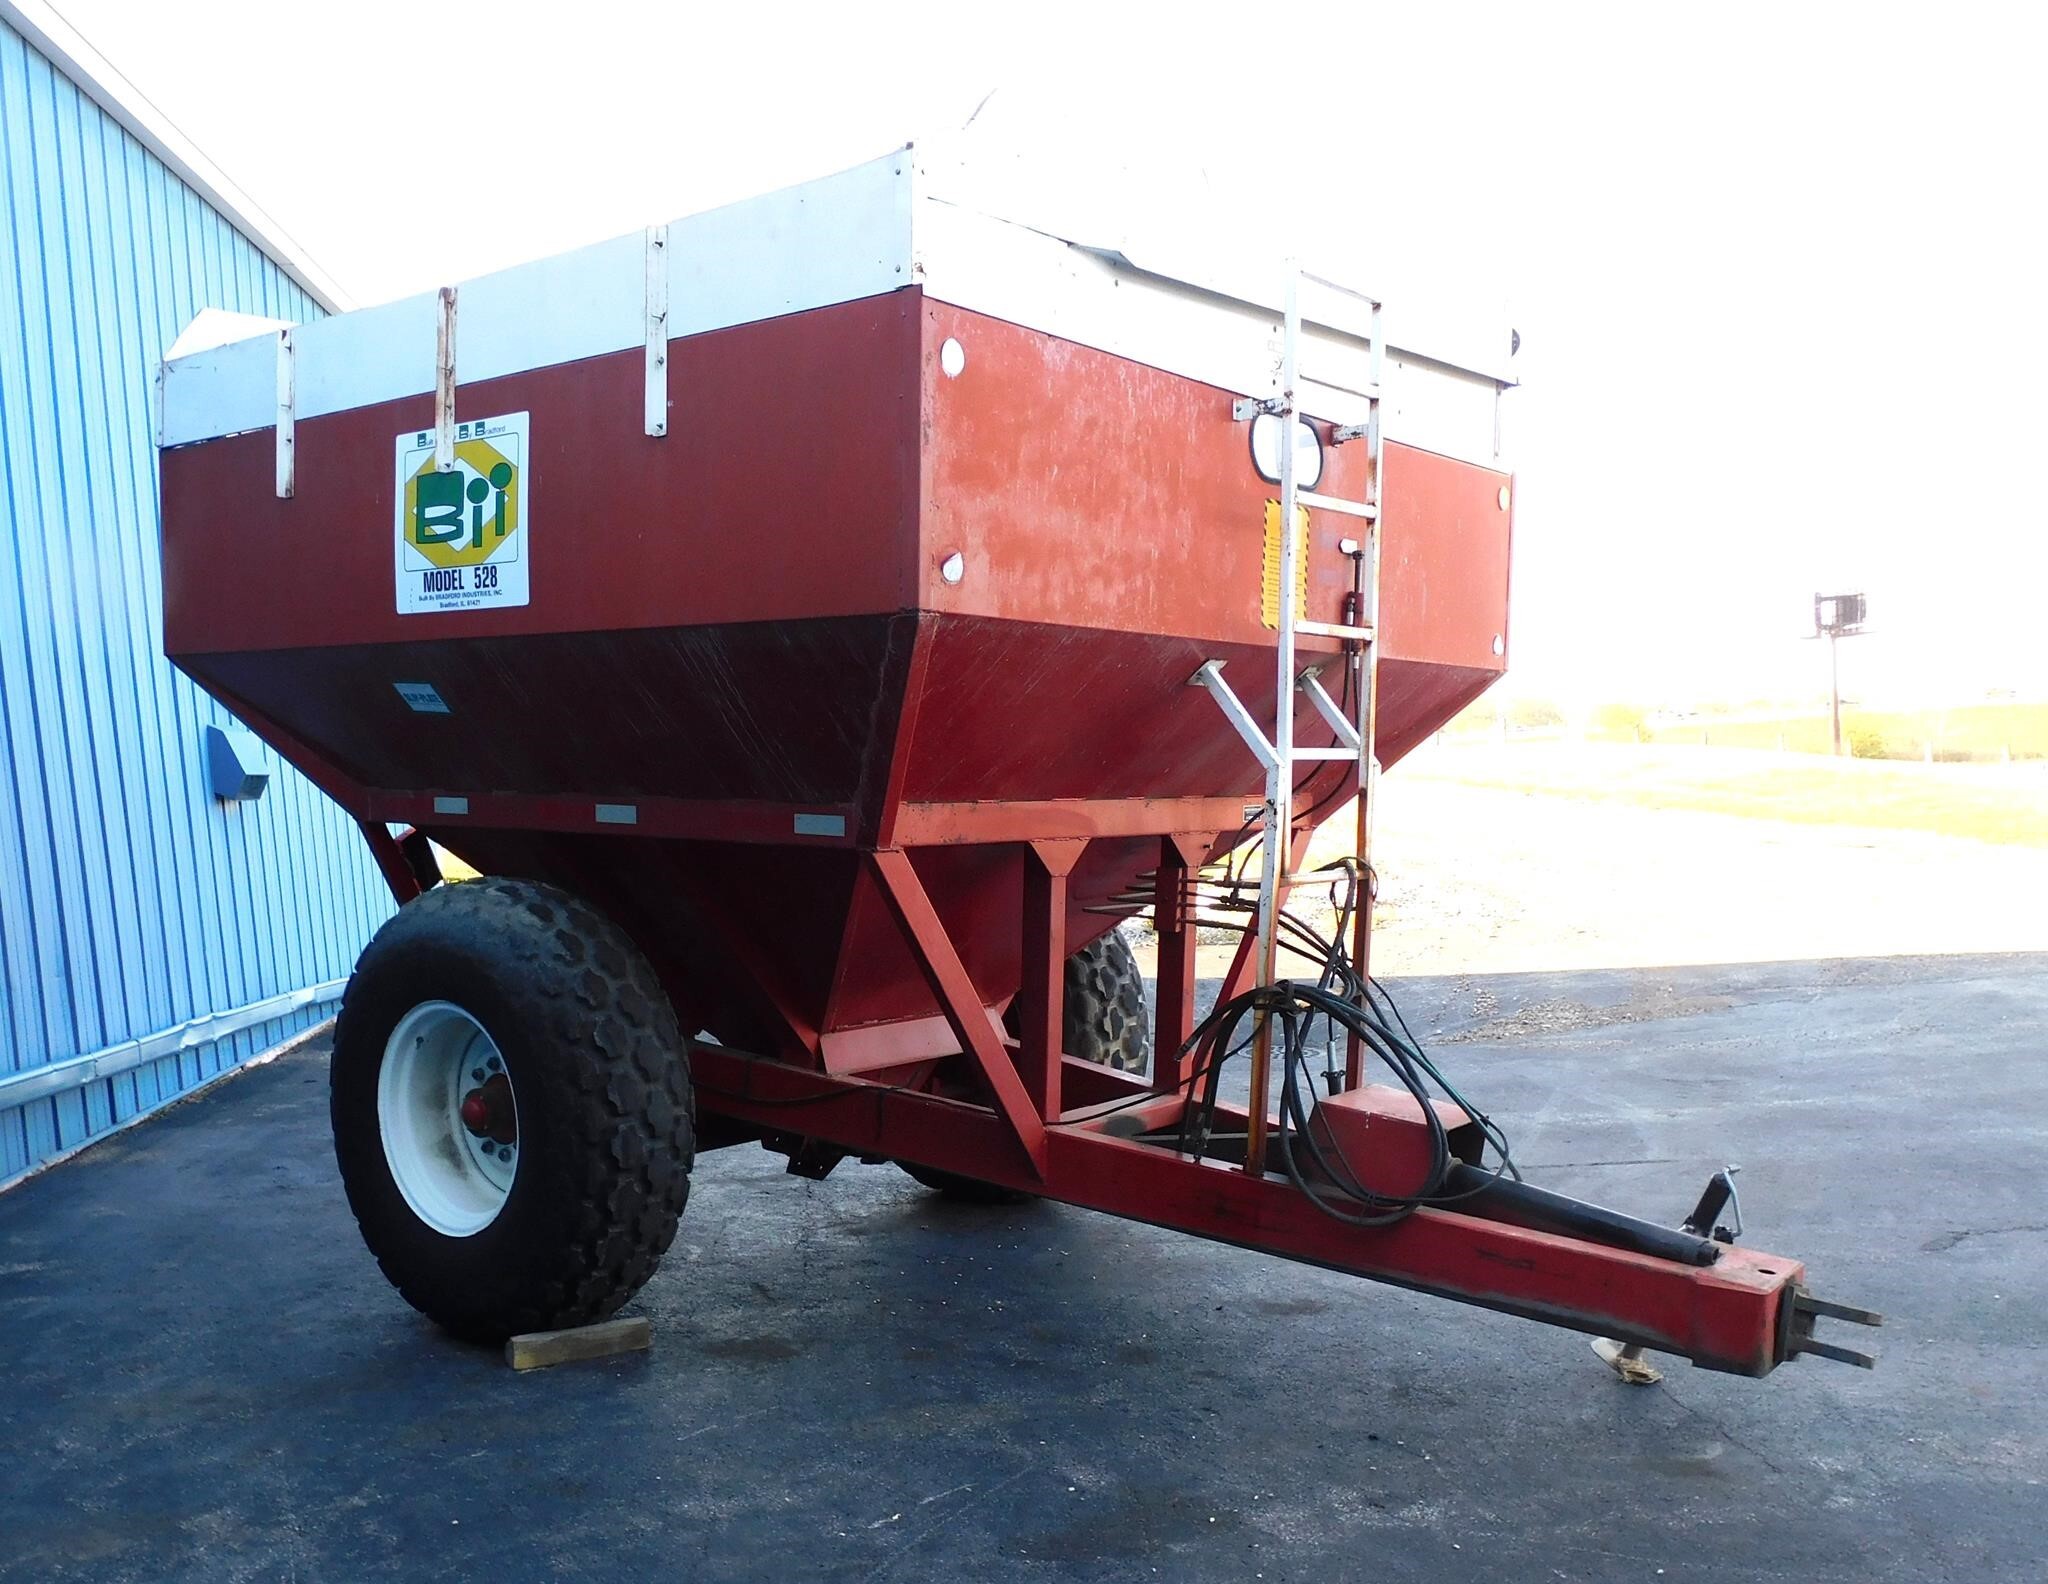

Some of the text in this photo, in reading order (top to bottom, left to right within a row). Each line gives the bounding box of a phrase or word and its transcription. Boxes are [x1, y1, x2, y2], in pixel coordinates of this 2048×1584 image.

[423, 565, 497, 593] MODEL 528
[435, 592, 460, 600] BRADFORD
